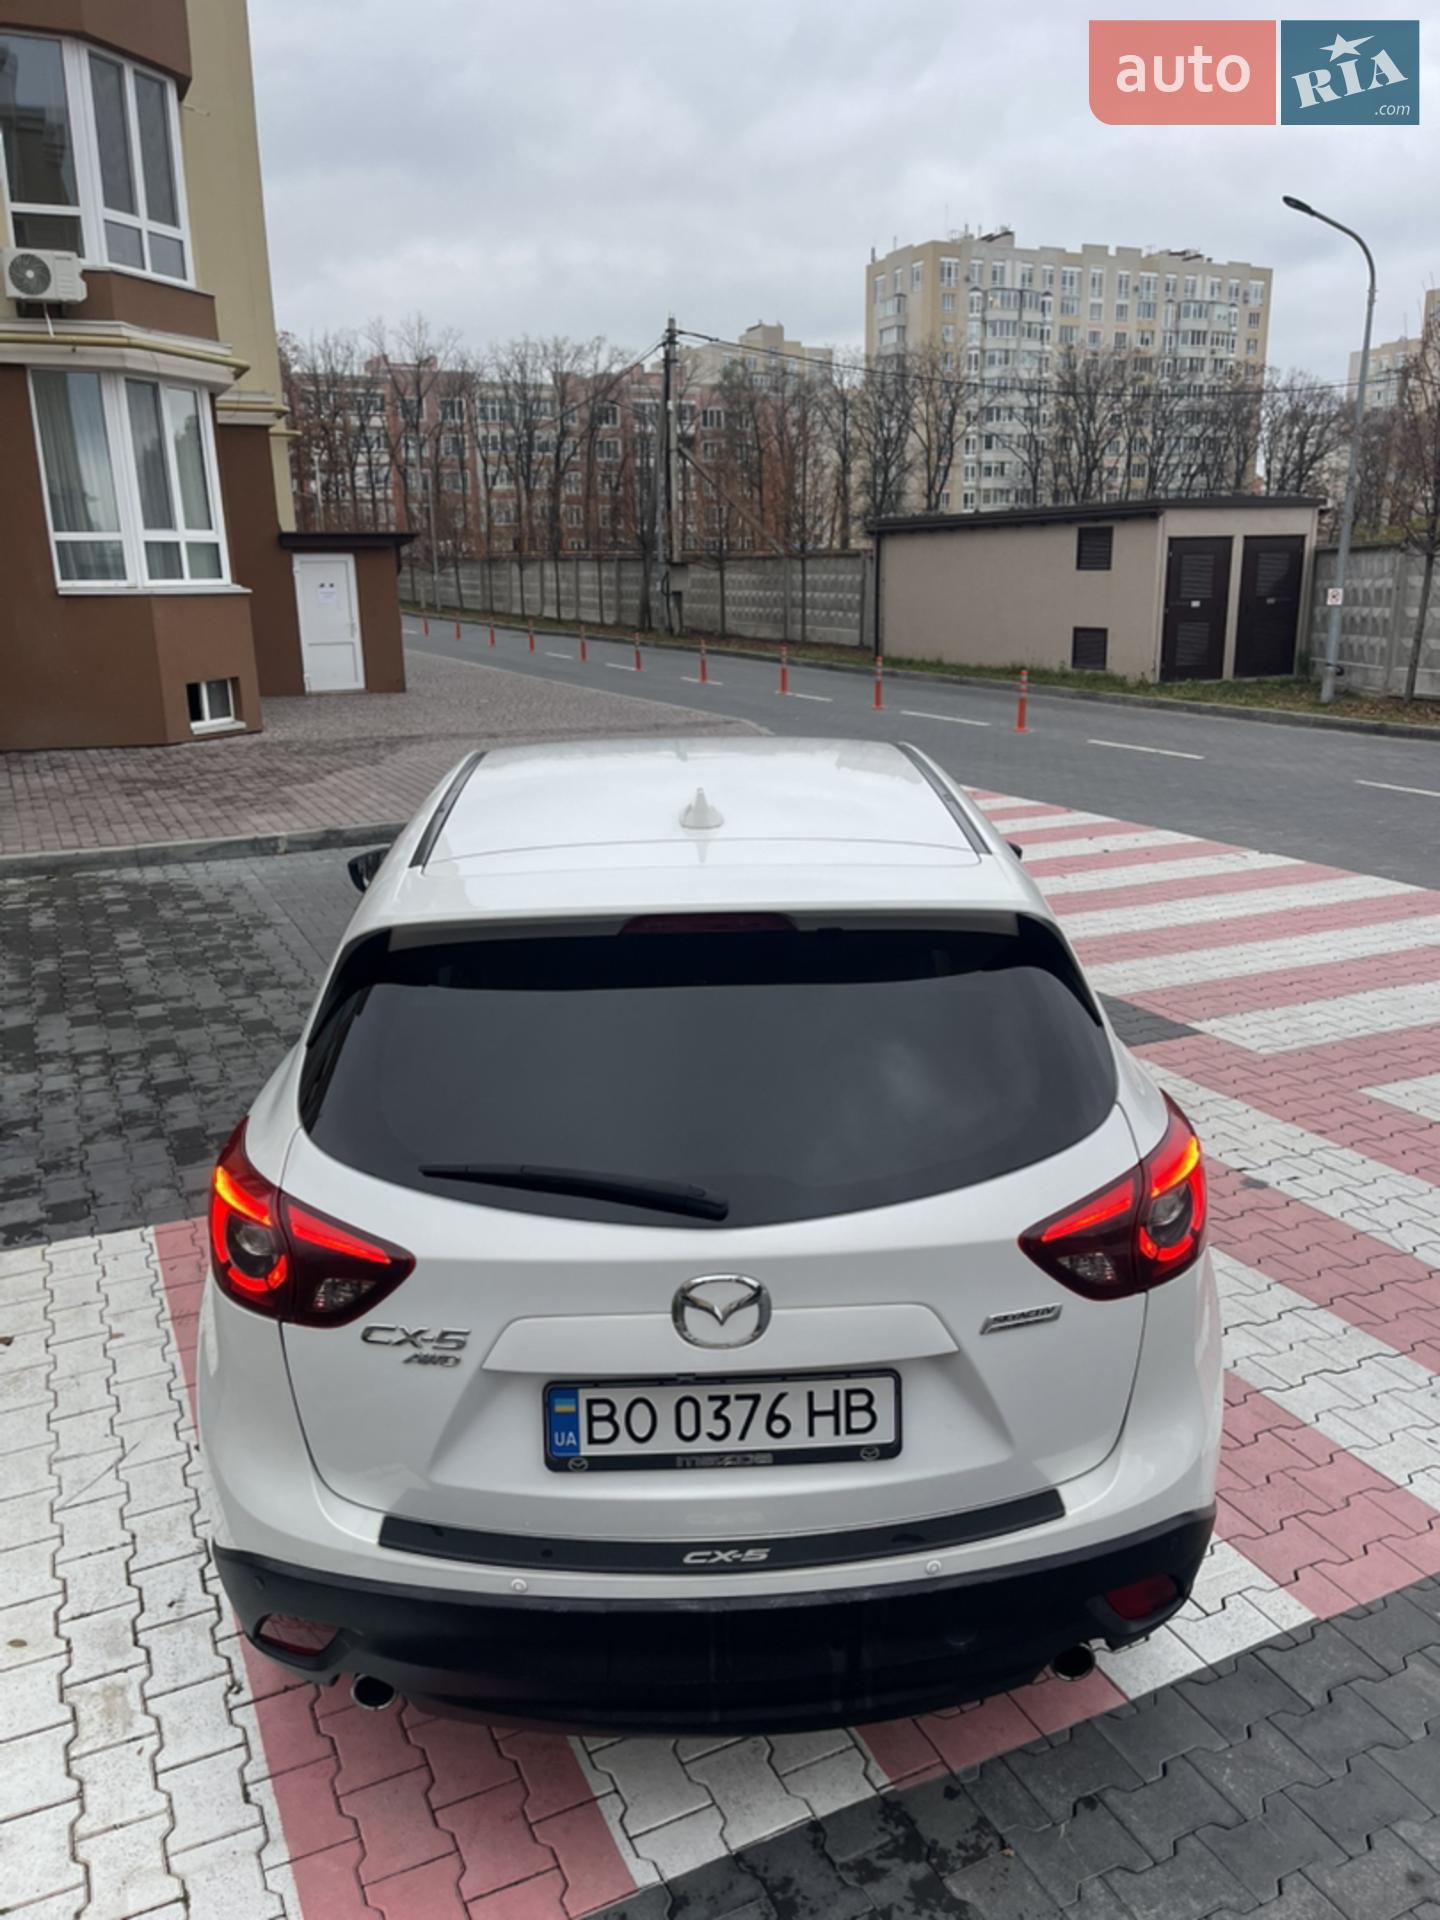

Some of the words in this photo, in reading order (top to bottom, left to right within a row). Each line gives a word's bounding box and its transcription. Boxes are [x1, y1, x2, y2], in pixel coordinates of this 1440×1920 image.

[360, 1323, 471, 1351] CX-5
[402, 1353, 461, 1368] AWD
[585, 1397, 657, 1445] BO
[674, 1391, 792, 1442] 0376
[806, 1387, 878, 1437] HB
[554, 1431, 577, 1446] UA
[682, 1548, 771, 1564] CX-5
